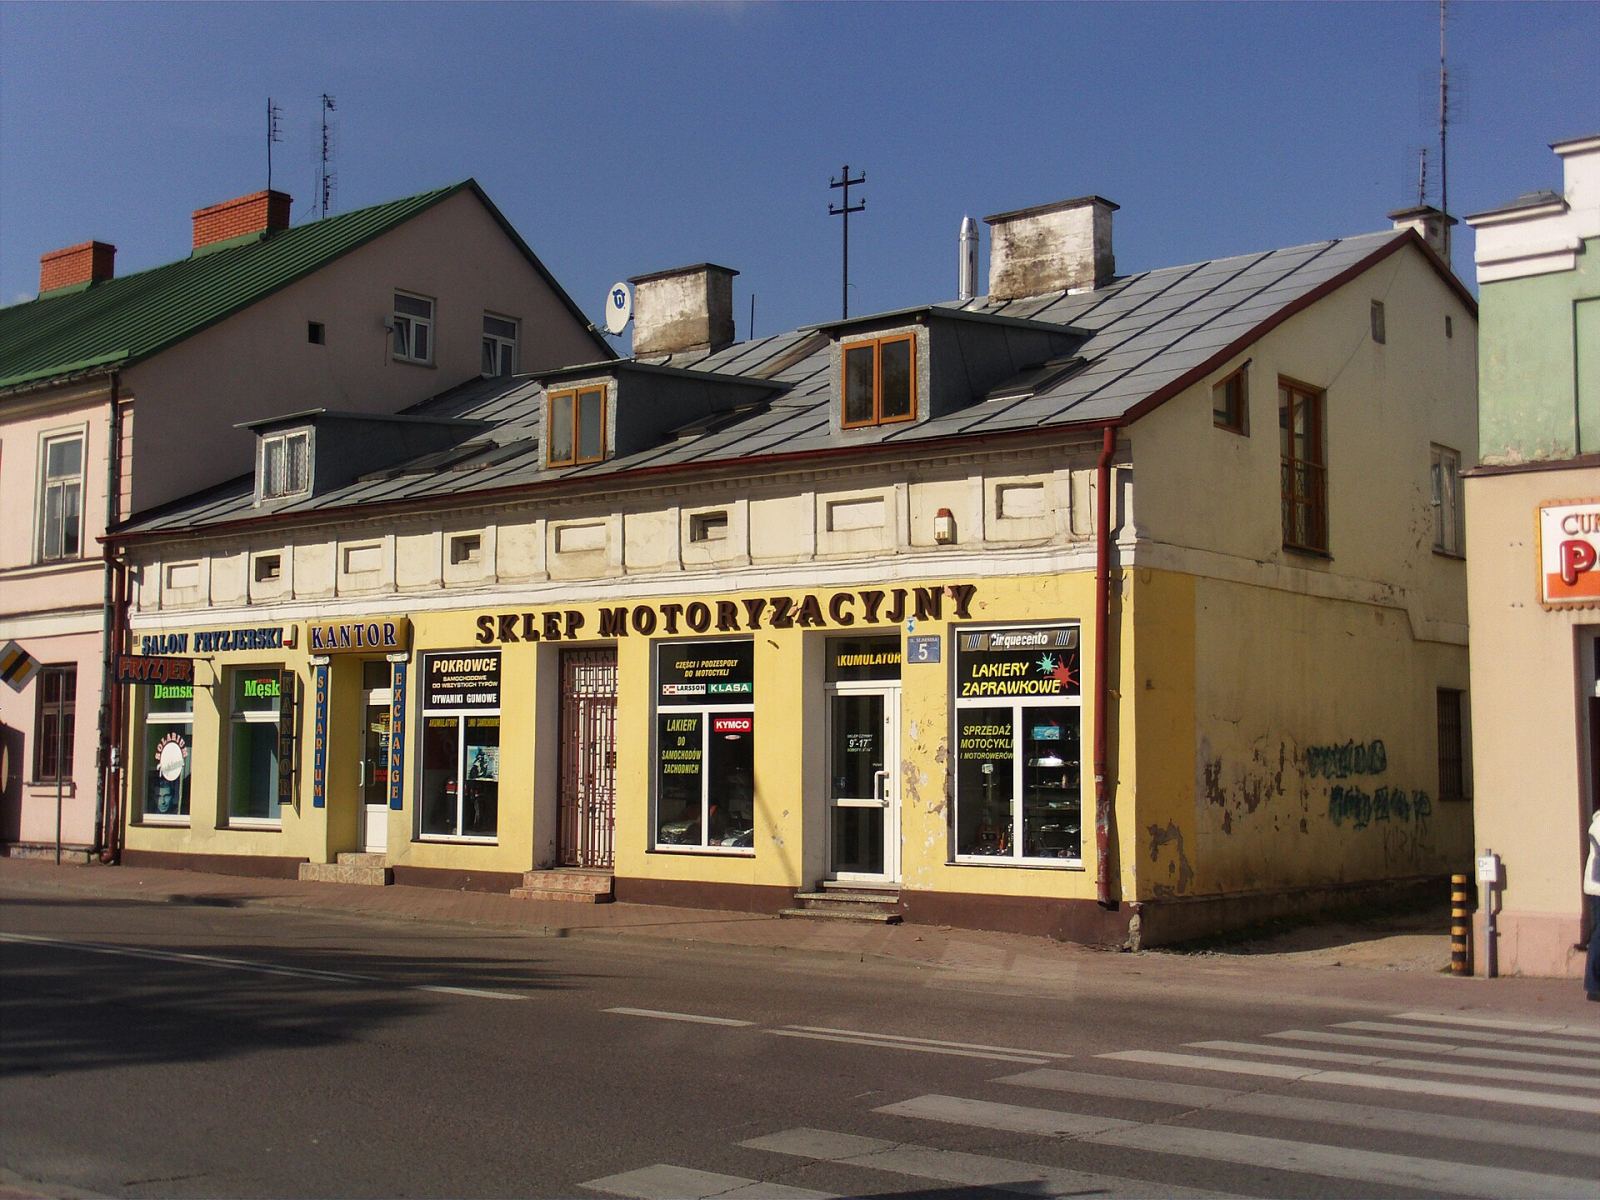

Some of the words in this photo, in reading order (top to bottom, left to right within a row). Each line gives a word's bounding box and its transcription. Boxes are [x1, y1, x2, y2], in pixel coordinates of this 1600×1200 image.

[1559, 539, 1600, 586] P
[476, 610, 585, 644] SKLEP
[597, 584, 977, 637] MOTORYZACYJNY
[142, 633, 188, 655] SALON
[193, 627, 283, 652] FRYZJERSKI
[311, 623, 397, 649] KANTOR
[918, 643, 928, 660] 5
[119, 656, 192, 682] FRYZJER
[432, 658, 498, 673] POKROWCE
[972, 662, 1030, 678] LAKIERY
[154, 684, 193, 699] Damsk
[244, 679, 280, 699] Męsk
[710, 683, 749, 693] KLASA
[962, 679, 1061, 696] ZAPRAWKOWE
[431, 693, 463, 704] DYWANIKI
[466, 693, 497, 703] GUMOWE
[666, 719, 698, 732] LAKIERY
[716, 720, 750, 729] KYMCO
[963, 723, 1012, 736] SPRZEDAŻ
[280, 677, 292, 796] KANTOR
[314, 676, 324, 797] SOLARIUM
[391, 673, 402, 798] EXCHANGE
[677, 736, 686, 746] DO
[155, 732, 188, 760] SOLARIUM
[661, 748, 702, 760] SAMOCHODÓW
[663, 763, 700, 774] ZACHODNICH
